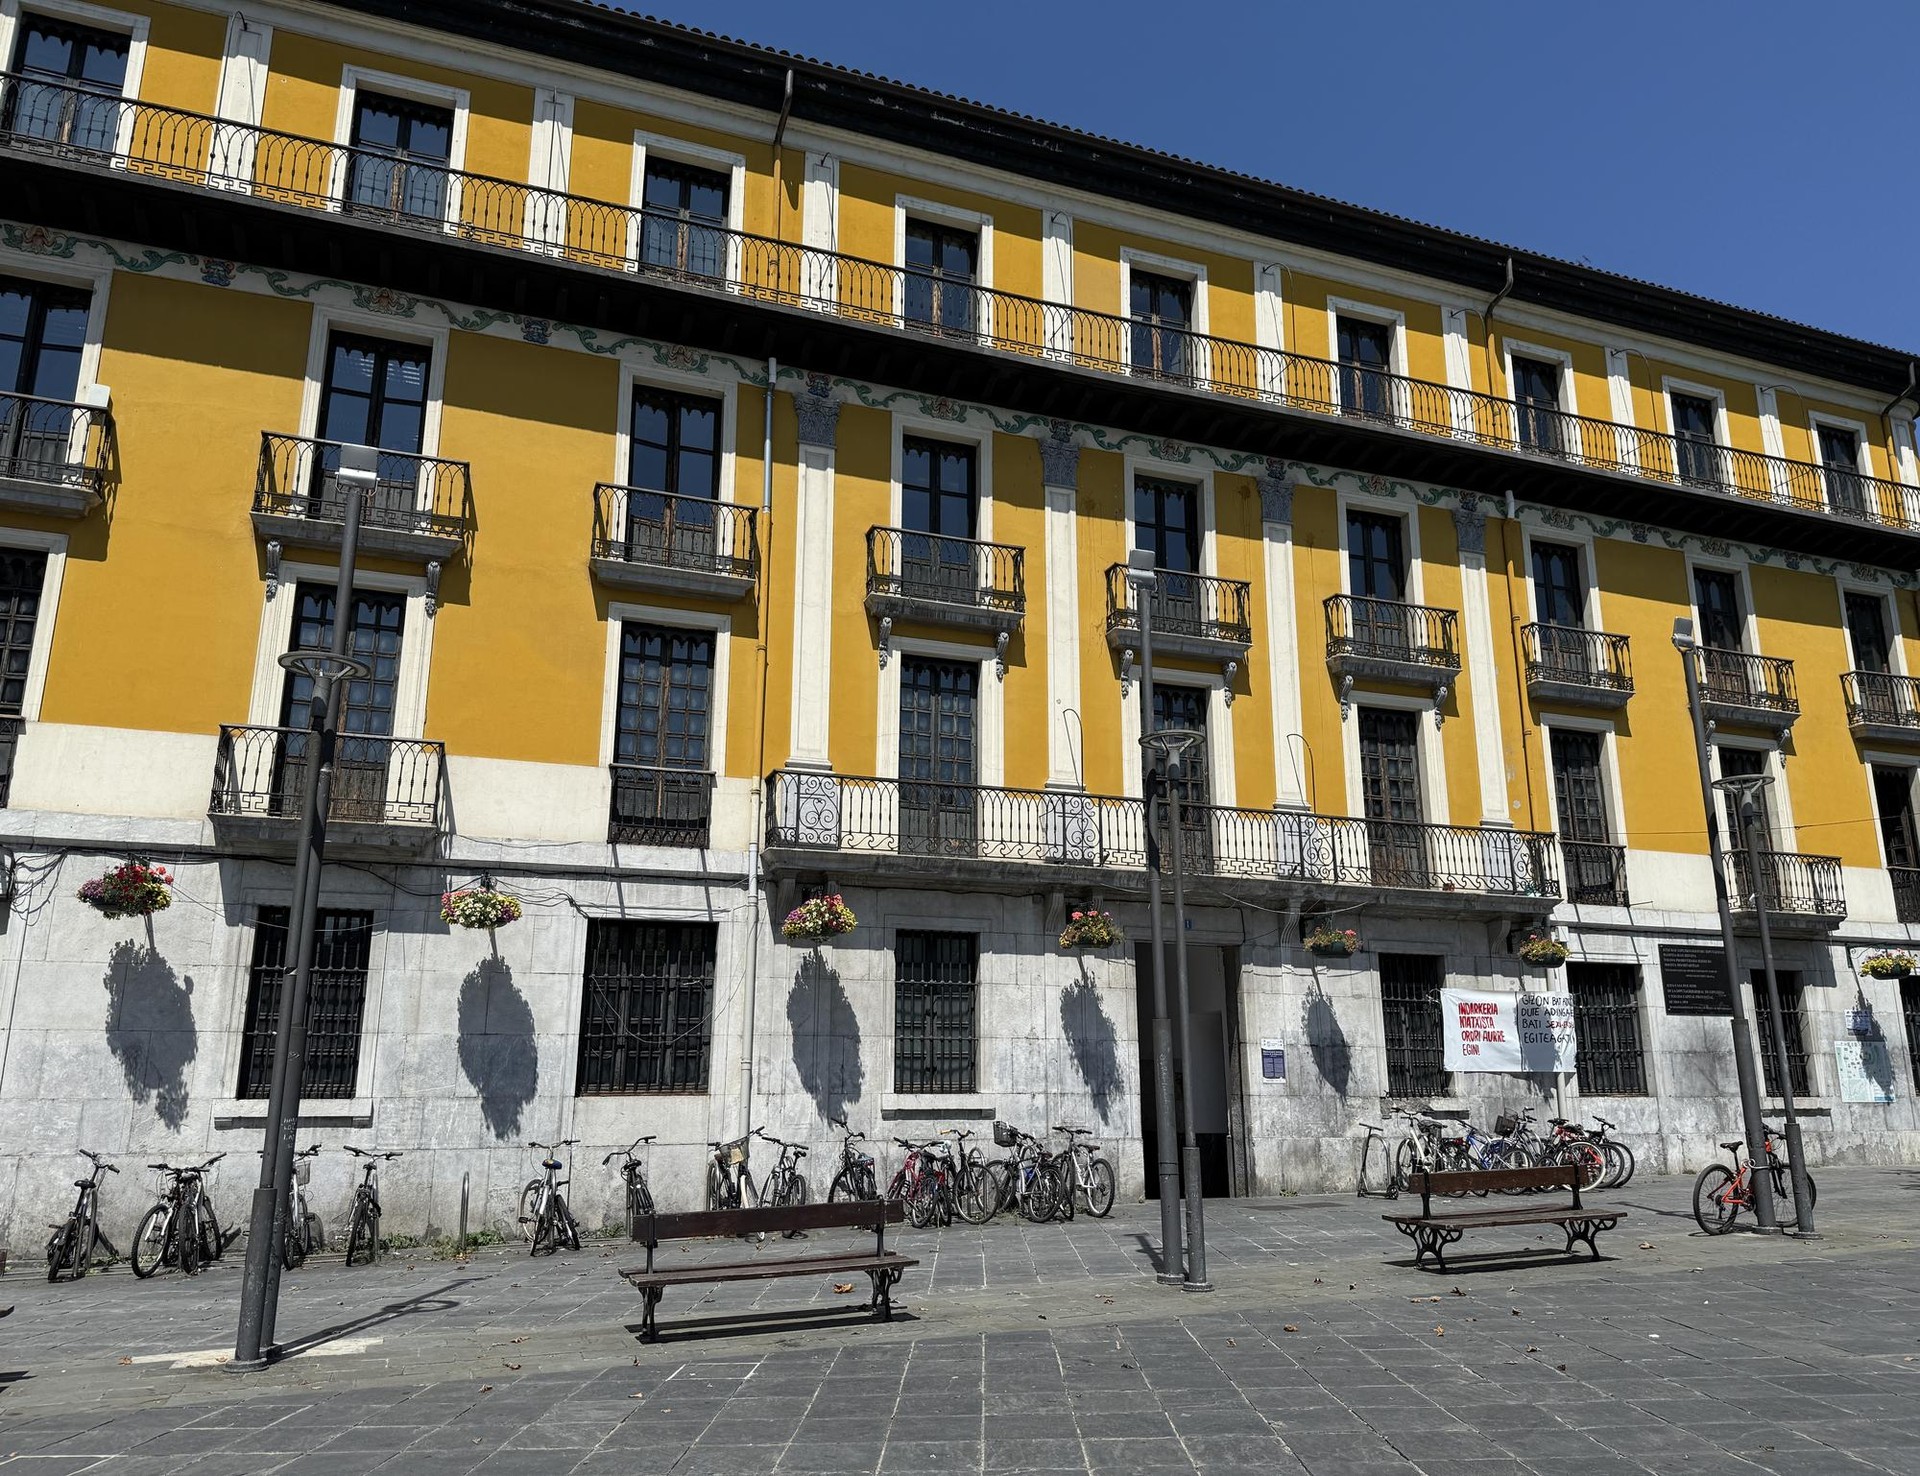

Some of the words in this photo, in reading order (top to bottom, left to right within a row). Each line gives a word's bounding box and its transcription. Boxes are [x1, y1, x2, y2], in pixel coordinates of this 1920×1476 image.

[1522, 994, 1549, 1006] GIZON
[1458, 1002, 1499, 1015] INDARKERIA
[1521, 1007, 1539, 1016] DUTE
[1459, 1016, 1496, 1029] MATXISTA
[1522, 1018, 1541, 1028] BATI
[1483, 1030, 1506, 1043] AURRE
